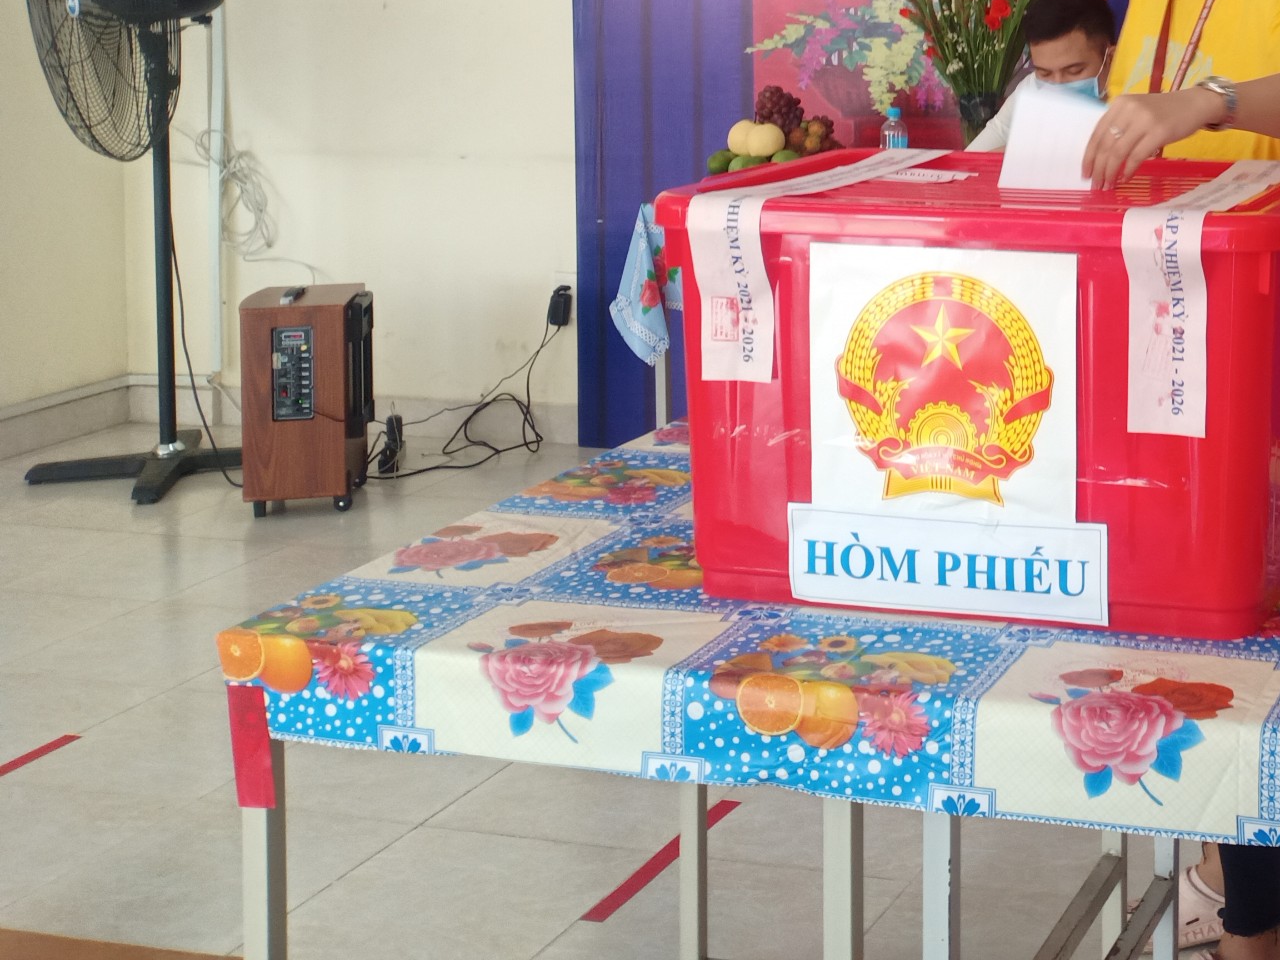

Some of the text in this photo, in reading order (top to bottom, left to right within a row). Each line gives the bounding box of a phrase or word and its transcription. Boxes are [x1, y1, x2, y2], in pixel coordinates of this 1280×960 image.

[1166, 208, 1184, 235] ẤP
[737, 281, 753, 312] 2021
[741, 329, 755, 362] 2026
[1171, 326, 1185, 361] 2021
[1171, 379, 1184, 415] 2026
[803, 532, 1090, 597] HÒM PHIẾU
